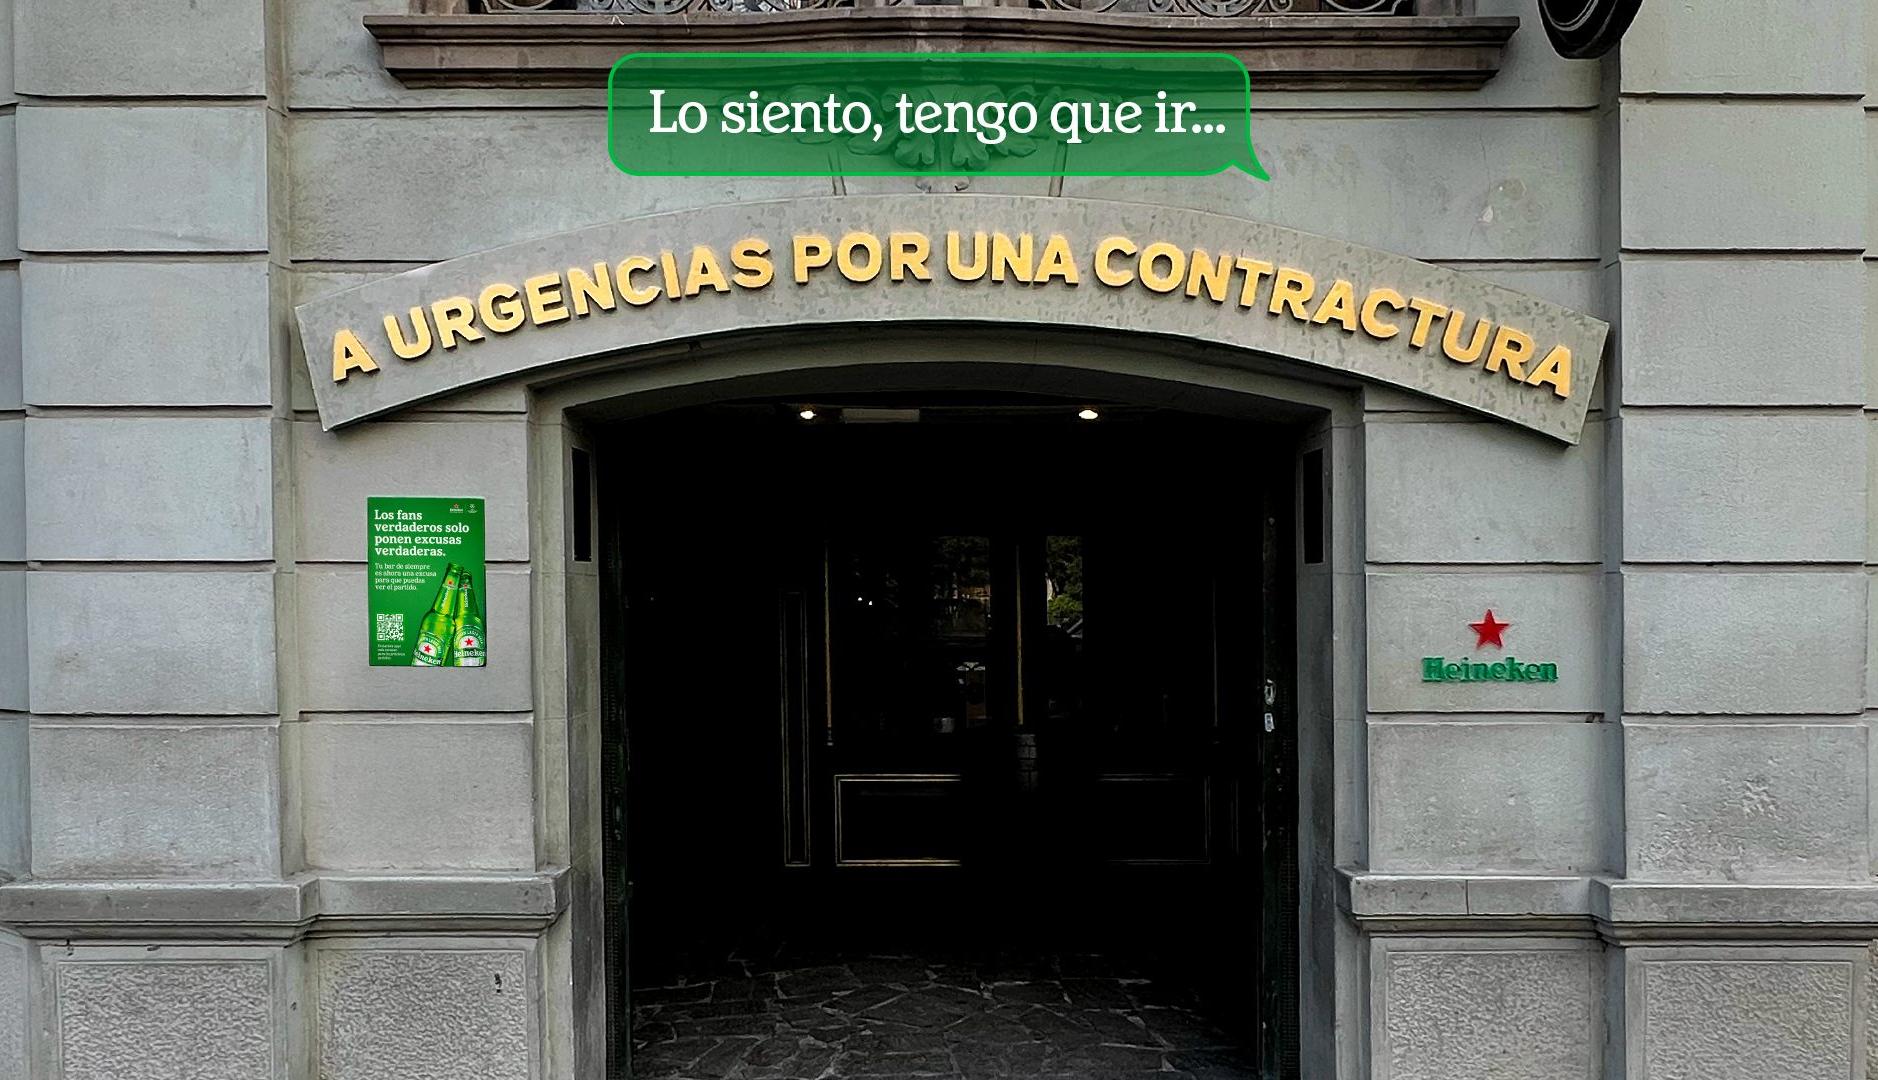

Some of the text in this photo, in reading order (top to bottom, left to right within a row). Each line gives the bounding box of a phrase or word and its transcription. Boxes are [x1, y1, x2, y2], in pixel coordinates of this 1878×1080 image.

[332, 230, 1574, 399] A URGENCIAS POR UNA CONTRACTURA
[374, 509, 423, 521] Los fans
[374, 521, 470, 533] verdaderos solo
[374, 535, 462, 547] ponen excusas
[374, 545, 446, 557] verdaderas.
[1421, 656, 1559, 684] Heineken
